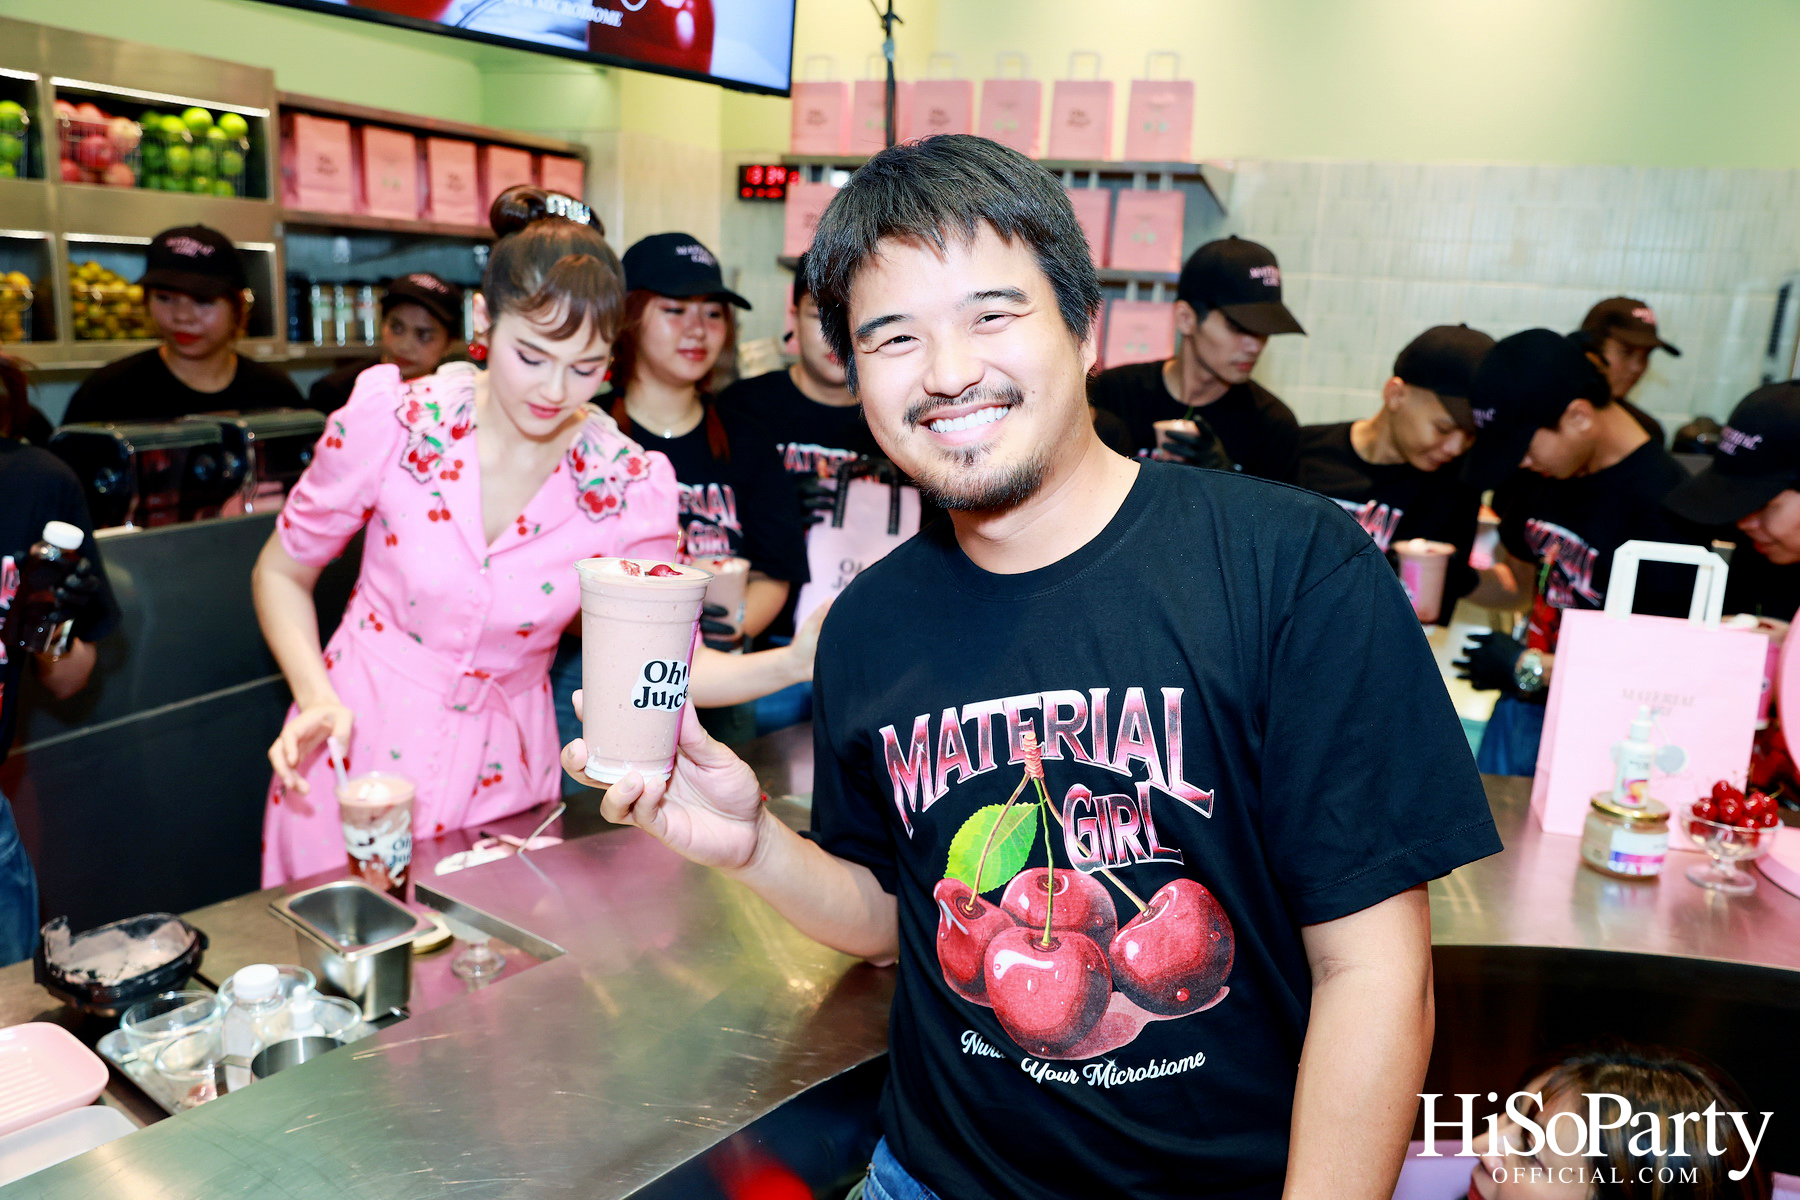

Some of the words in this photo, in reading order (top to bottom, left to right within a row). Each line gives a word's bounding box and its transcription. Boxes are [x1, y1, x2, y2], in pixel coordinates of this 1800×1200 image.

[878, 687, 1214, 839] MATERIAL
[1062, 780, 1185, 874] GIRL
[1021, 1057, 1080, 1084] Your
[1082, 1051, 1207, 1089] Microbiome
